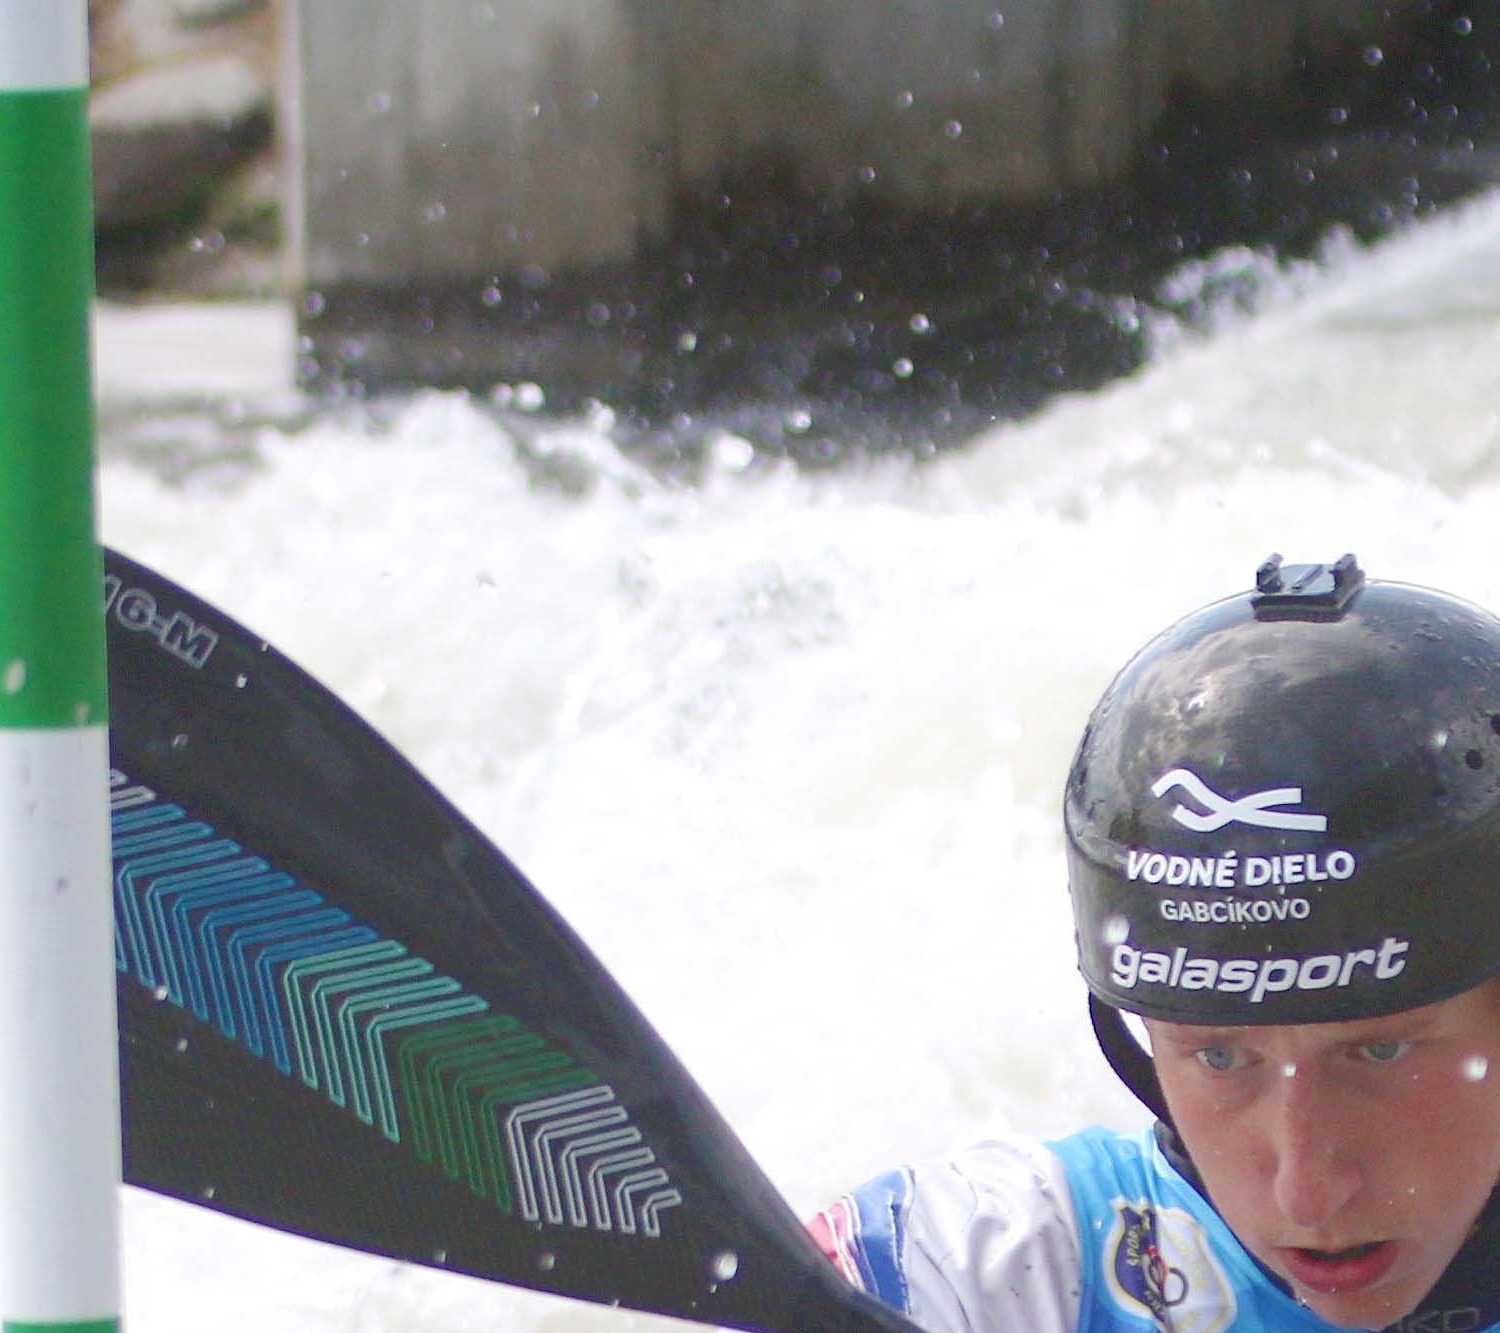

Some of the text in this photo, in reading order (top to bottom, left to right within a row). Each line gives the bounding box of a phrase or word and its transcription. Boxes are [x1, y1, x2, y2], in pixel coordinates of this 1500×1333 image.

[1127, 850, 1356, 888] VODNÉ DIELO
[1111, 937, 1409, 1002] galasport
